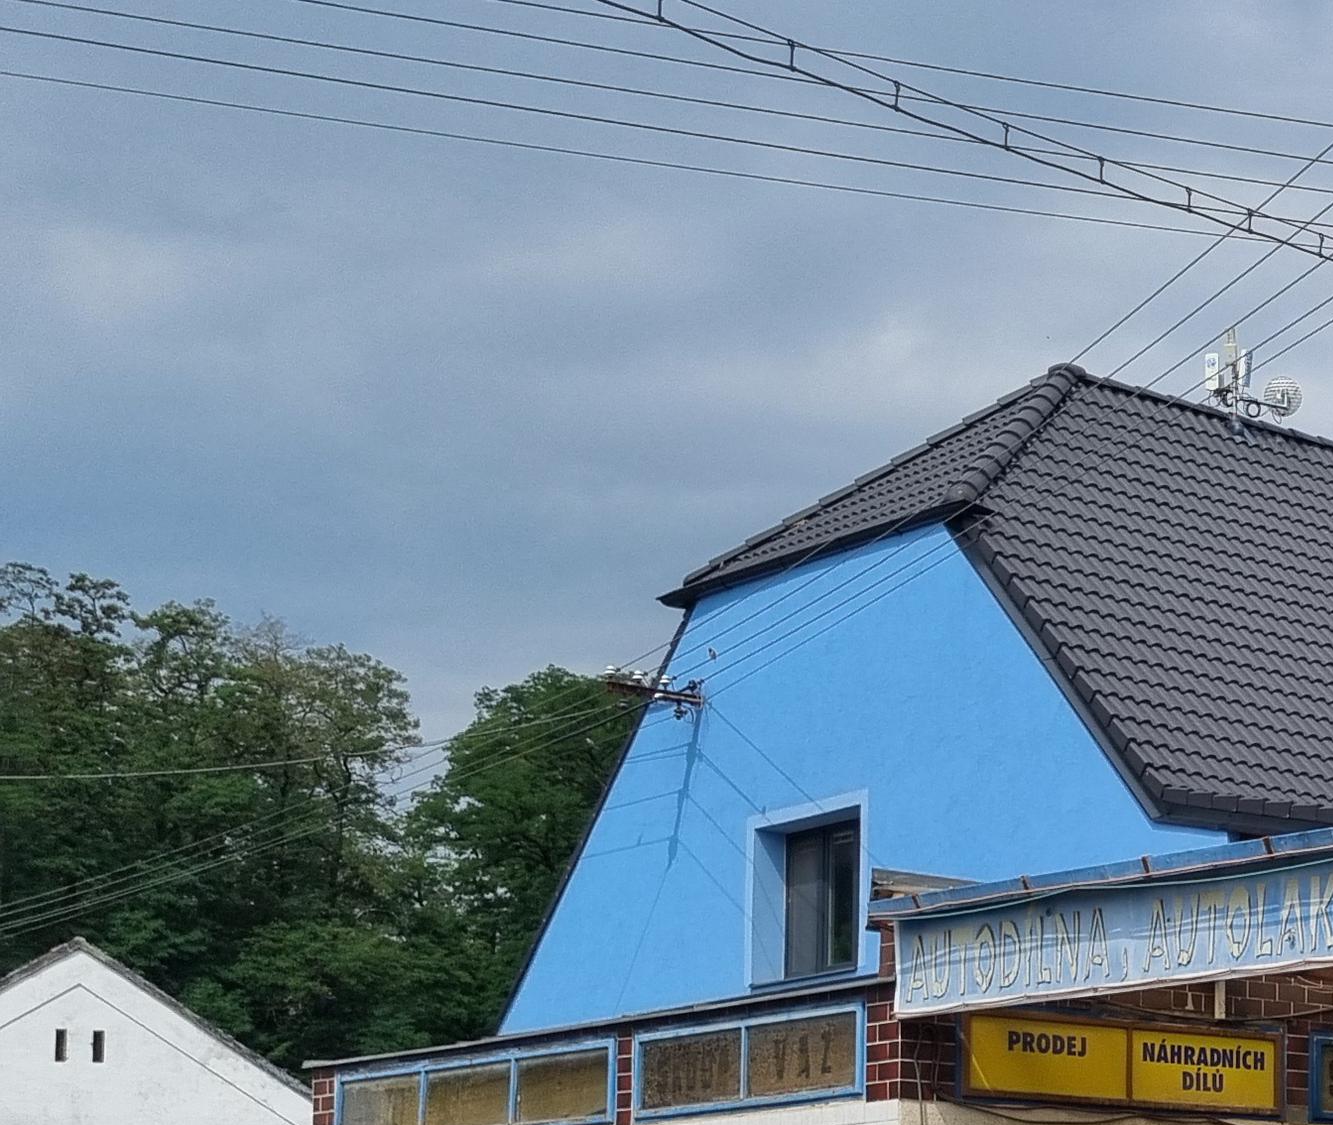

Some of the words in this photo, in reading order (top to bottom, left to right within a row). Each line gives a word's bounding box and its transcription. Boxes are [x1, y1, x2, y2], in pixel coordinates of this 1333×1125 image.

[1007, 1030, 1088, 1058] PRODEJ
[1141, 1038, 1266, 1071] NÁHRADNÍCH
[1181, 1068, 1225, 1093] DÍLŮ
